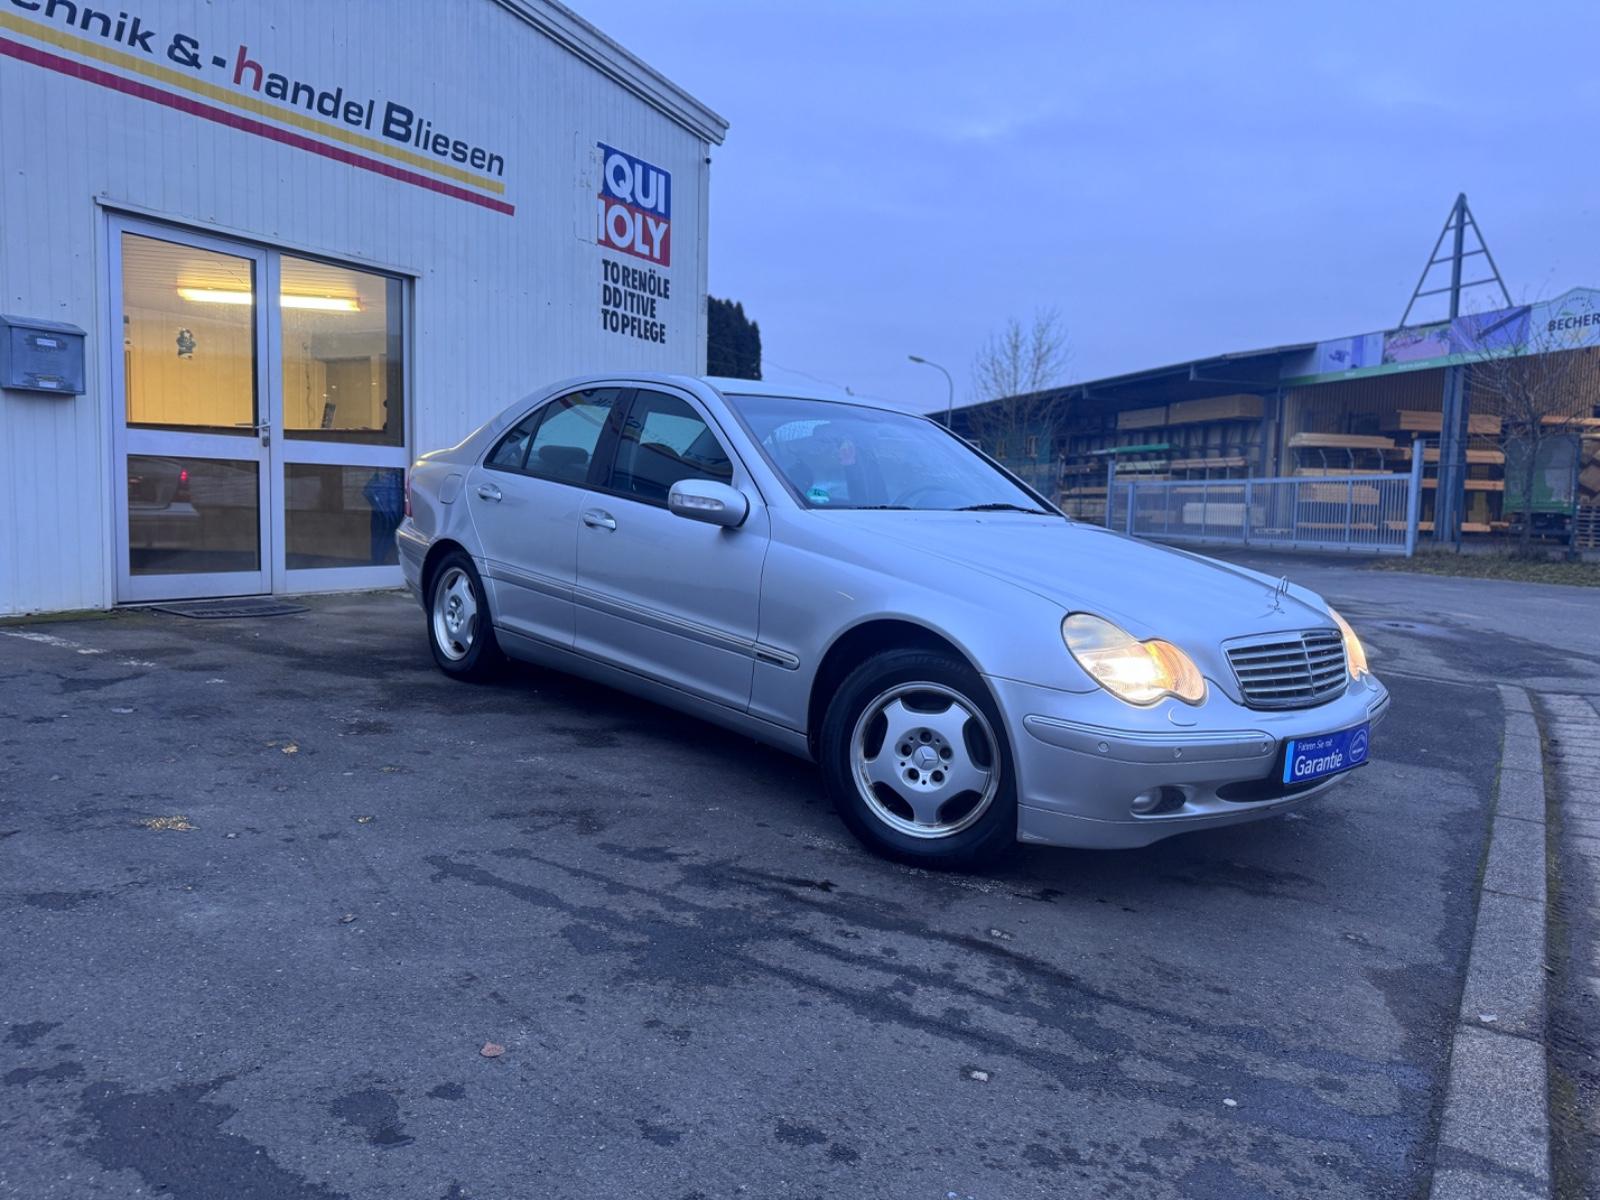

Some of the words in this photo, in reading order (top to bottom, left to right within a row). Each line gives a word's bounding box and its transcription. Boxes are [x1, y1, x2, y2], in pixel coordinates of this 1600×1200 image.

[167, 33, 202, 70] &
[382, 101, 504, 176] Bliesen
[1548, 312, 1600, 332] BECHER
[1294, 748, 1343, 776] Garantie
